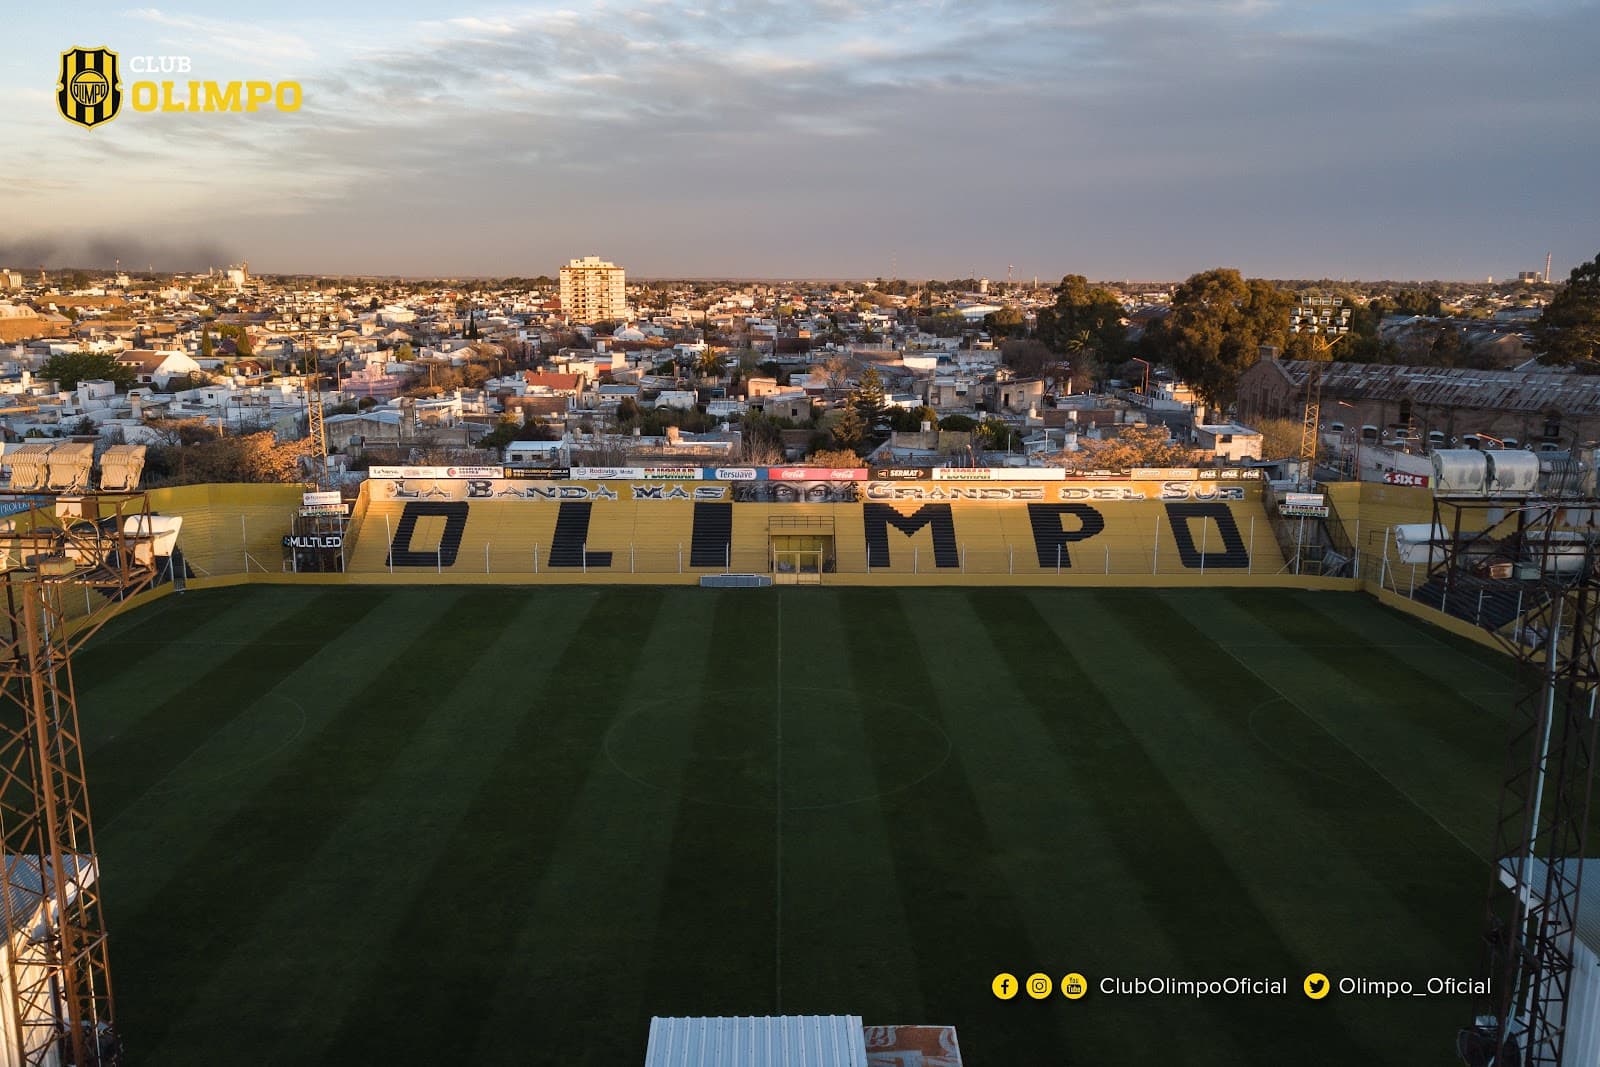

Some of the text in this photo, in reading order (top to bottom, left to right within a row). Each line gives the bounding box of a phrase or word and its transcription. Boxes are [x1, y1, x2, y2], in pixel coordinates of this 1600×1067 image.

[720, 469, 753, 479] Tersuave
[890, 469, 918, 477] SERMAT
[393, 479, 1244, 501] LA BANDA MAS GRANDE DEL SUR
[290, 536, 341, 548] MULTILED
